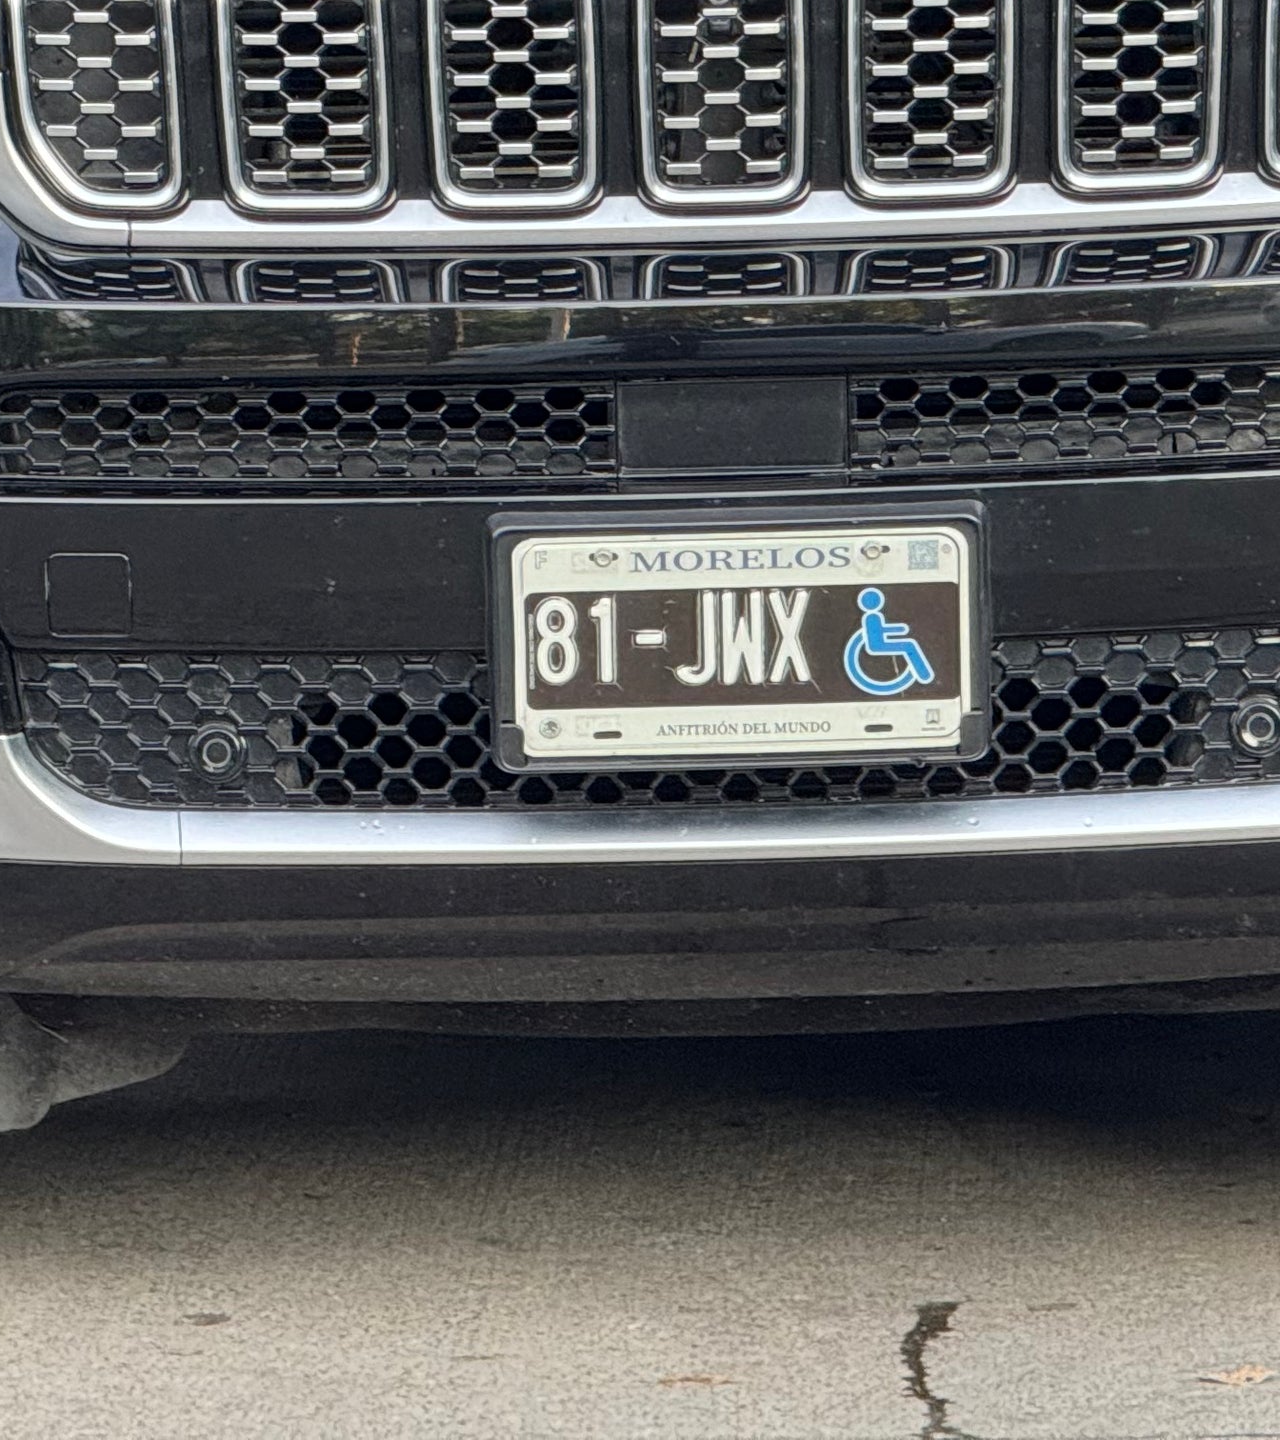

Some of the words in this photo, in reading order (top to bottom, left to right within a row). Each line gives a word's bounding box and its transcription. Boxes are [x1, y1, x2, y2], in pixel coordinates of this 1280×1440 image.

[629, 546, 851, 573] MORELOS
[535, 588, 814, 686] 81-JWX
[656, 720, 738, 737] ANFITRIÓN
[742, 722, 770, 735] DEL
[773, 720, 831, 735] MUNDO
